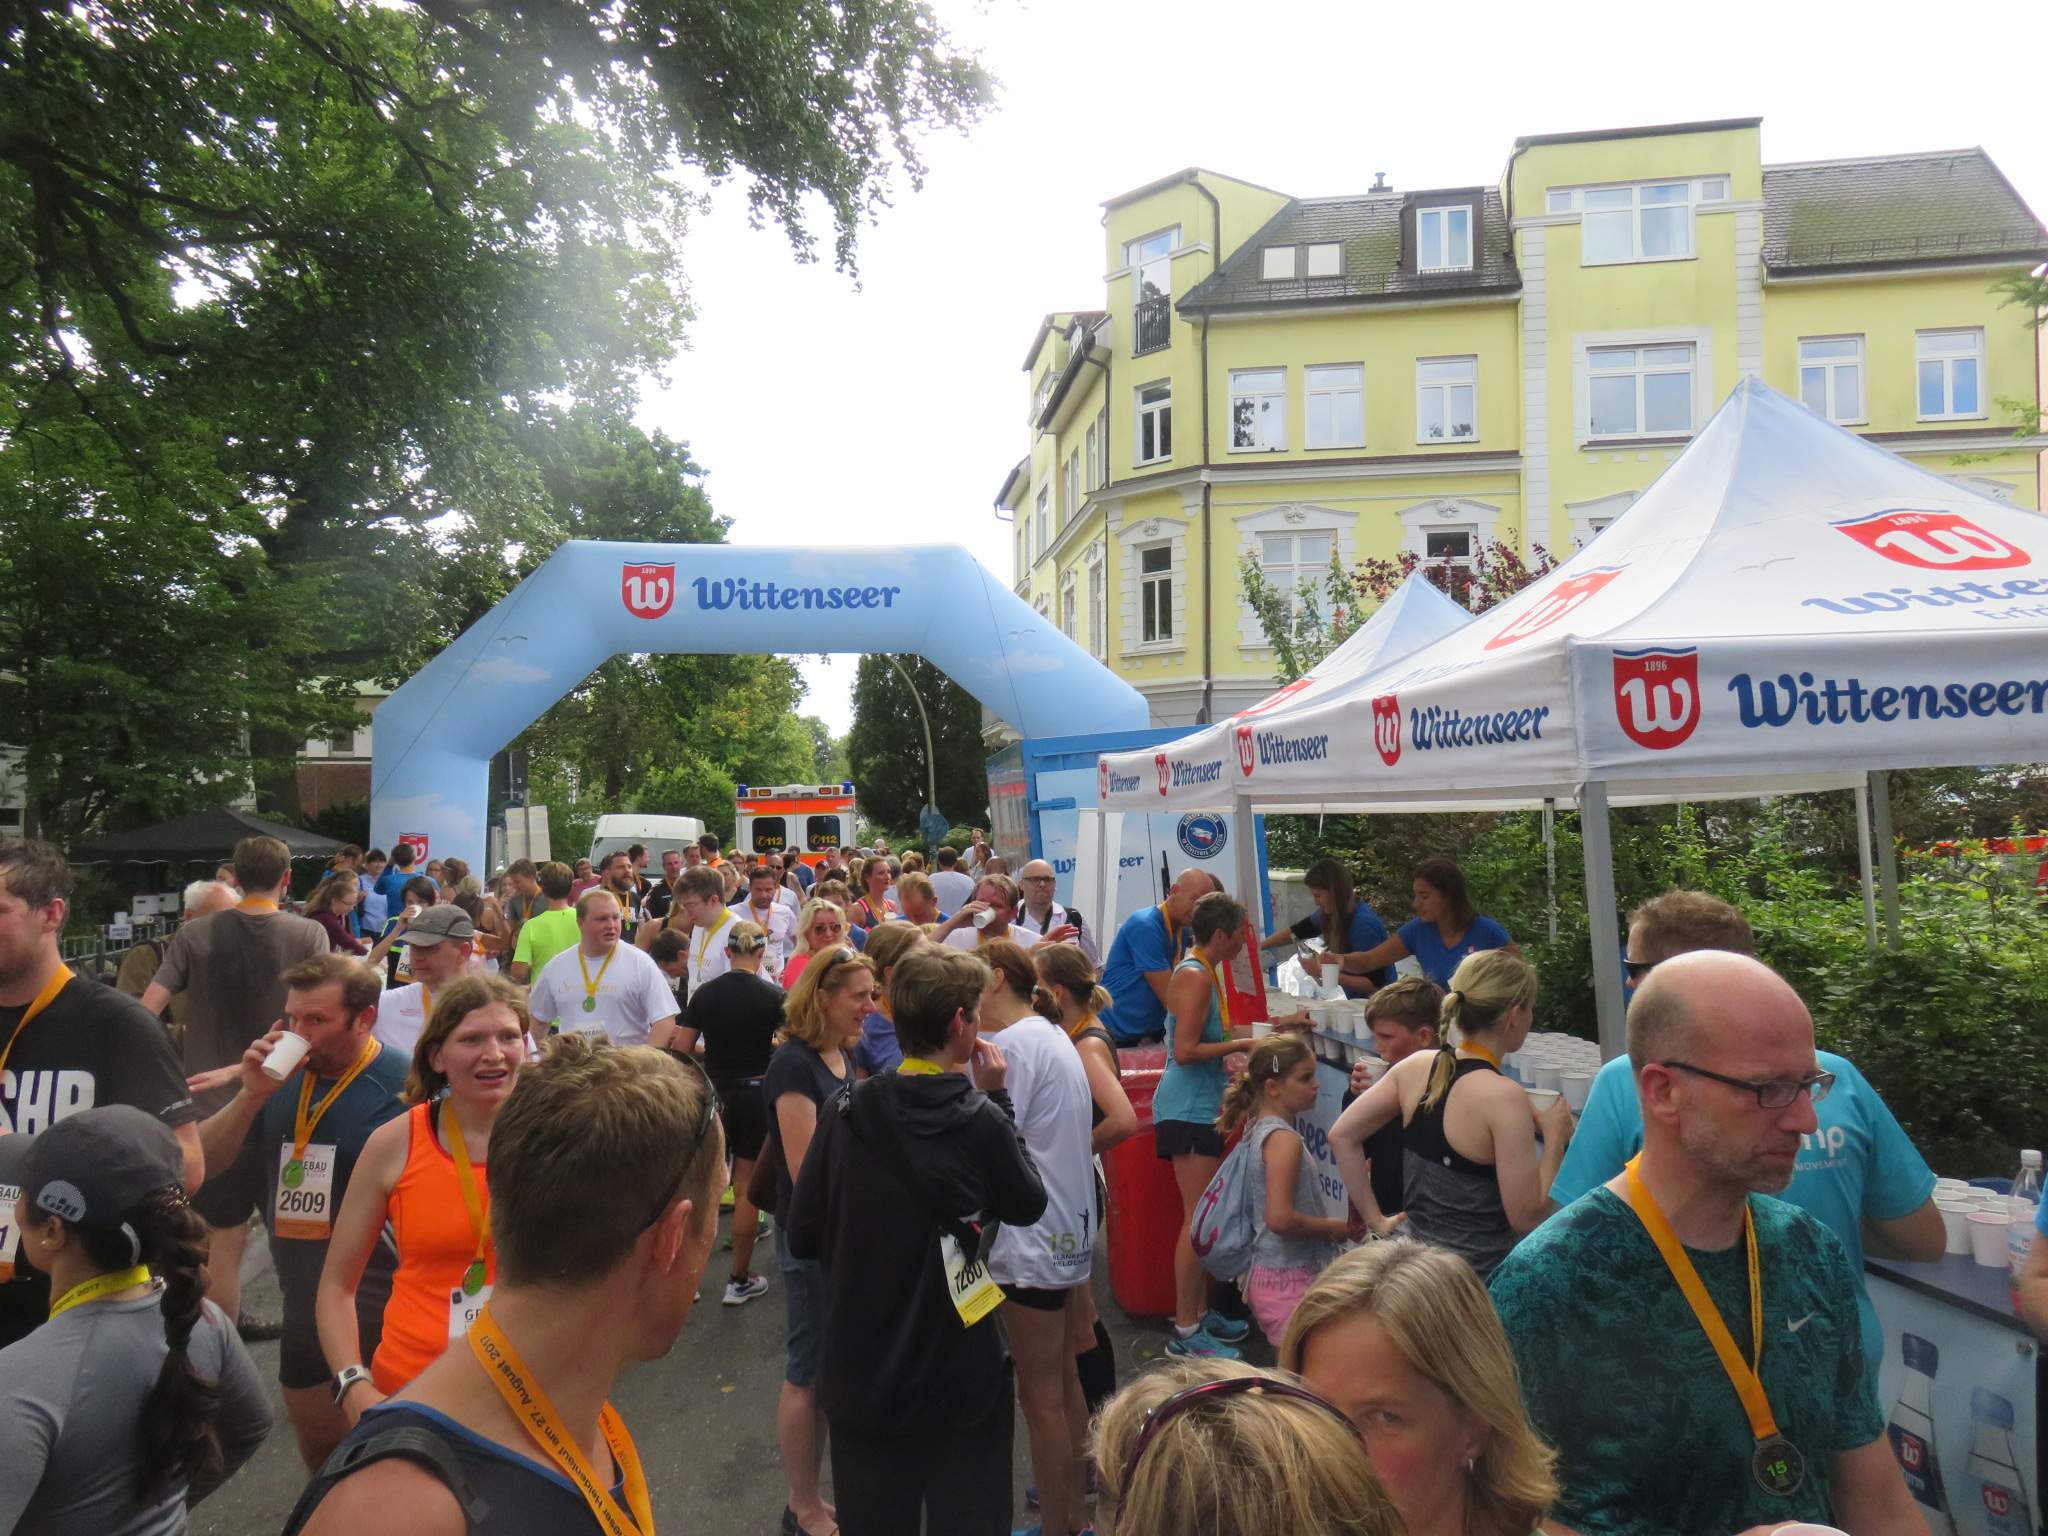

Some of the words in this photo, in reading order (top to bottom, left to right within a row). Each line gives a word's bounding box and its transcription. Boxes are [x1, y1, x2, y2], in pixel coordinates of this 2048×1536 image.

[692, 576, 901, 610] Wittenseer
[1801, 577, 2048, 615] Witte
[1644, 661, 1668, 672] 1896
[1727, 672, 2048, 728] Wittenseer
[1410, 705, 1550, 750] Wittenseer
[1256, 732, 1329, 766] Wittenseer
[1109, 770, 1140, 793] Wittenseer
[1171, 759, 1222, 787] Wittenseer
[767, 836, 784, 846] 112
[821, 835, 838, 844] 112
[279, 1190, 326, 1213] 2609
[1047, 1233, 1076, 1253] 15
[954, 1262, 983, 1295] 1280
[497, 1360, 533, 1406] August
[530, 1406, 547, 1428] 27.
[544, 1427, 561, 1447] am
[1766, 1459, 1789, 1478] 15
